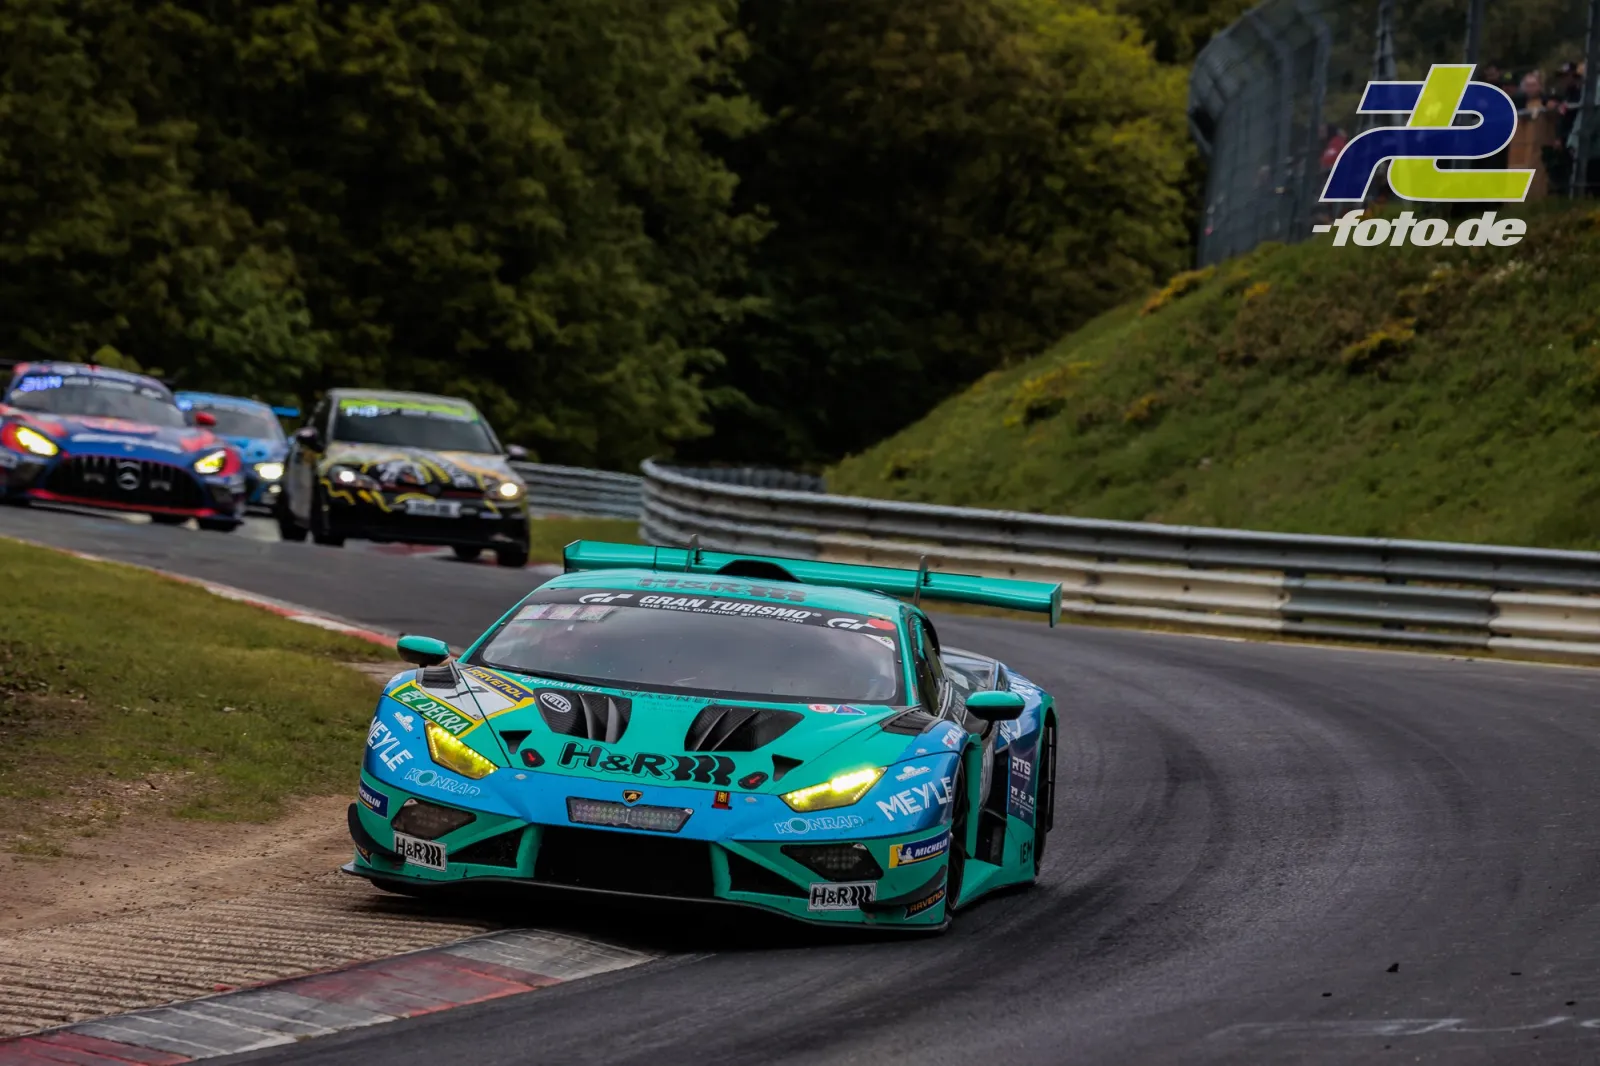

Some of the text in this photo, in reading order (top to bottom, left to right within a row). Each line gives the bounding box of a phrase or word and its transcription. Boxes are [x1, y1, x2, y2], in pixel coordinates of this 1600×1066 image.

[639, 595, 707, 608] GRAN
[740, 612, 804, 623] SIATOR
[467, 668, 525, 699] RAVENOL
[520, 677, 603, 693] GRAHAM HILL
[416, 700, 470, 735] DEKRA
[552, 741, 677, 781] H&R
[1012, 757, 1031, 776] RTS
[404, 767, 481, 797] KONRAD
[359, 787, 382, 808] HELIN
[876, 776, 953, 822] MEYLE
[774, 815, 864, 834] KONRAD
[394, 836, 424, 861] H&R
[915, 838, 948, 858] MICHELIN
[811, 886, 849, 906] H&R
